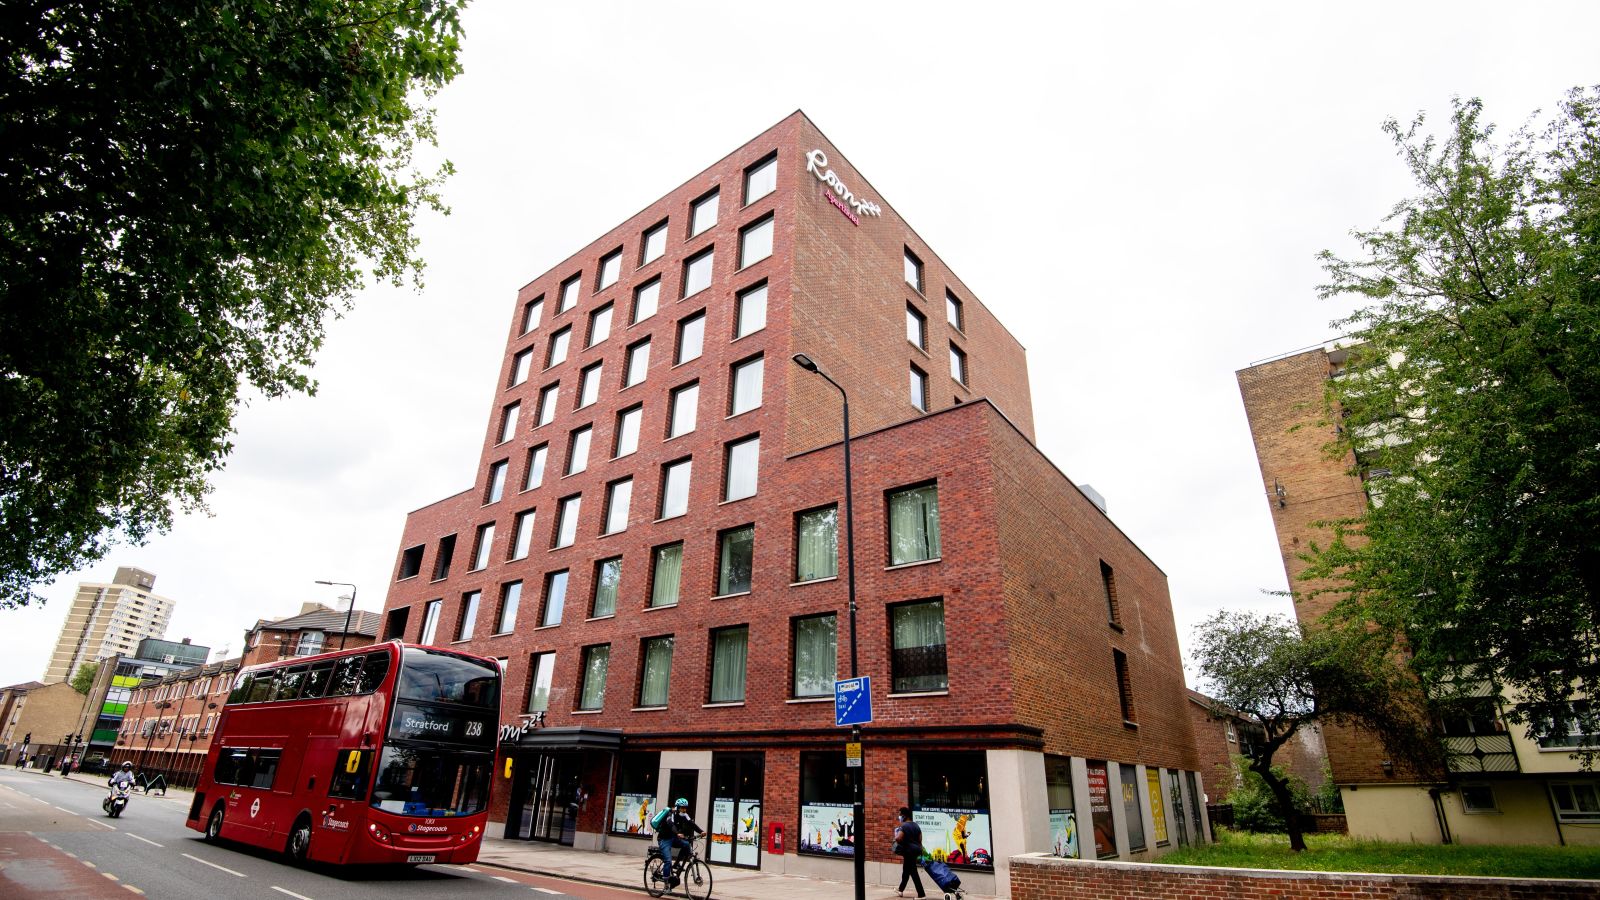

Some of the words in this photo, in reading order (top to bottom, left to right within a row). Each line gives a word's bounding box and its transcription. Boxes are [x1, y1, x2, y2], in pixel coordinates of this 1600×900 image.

[405, 717, 450, 732] Stratford
[465, 721, 483, 737] 238
[416, 824, 448, 833] Stagecoach
